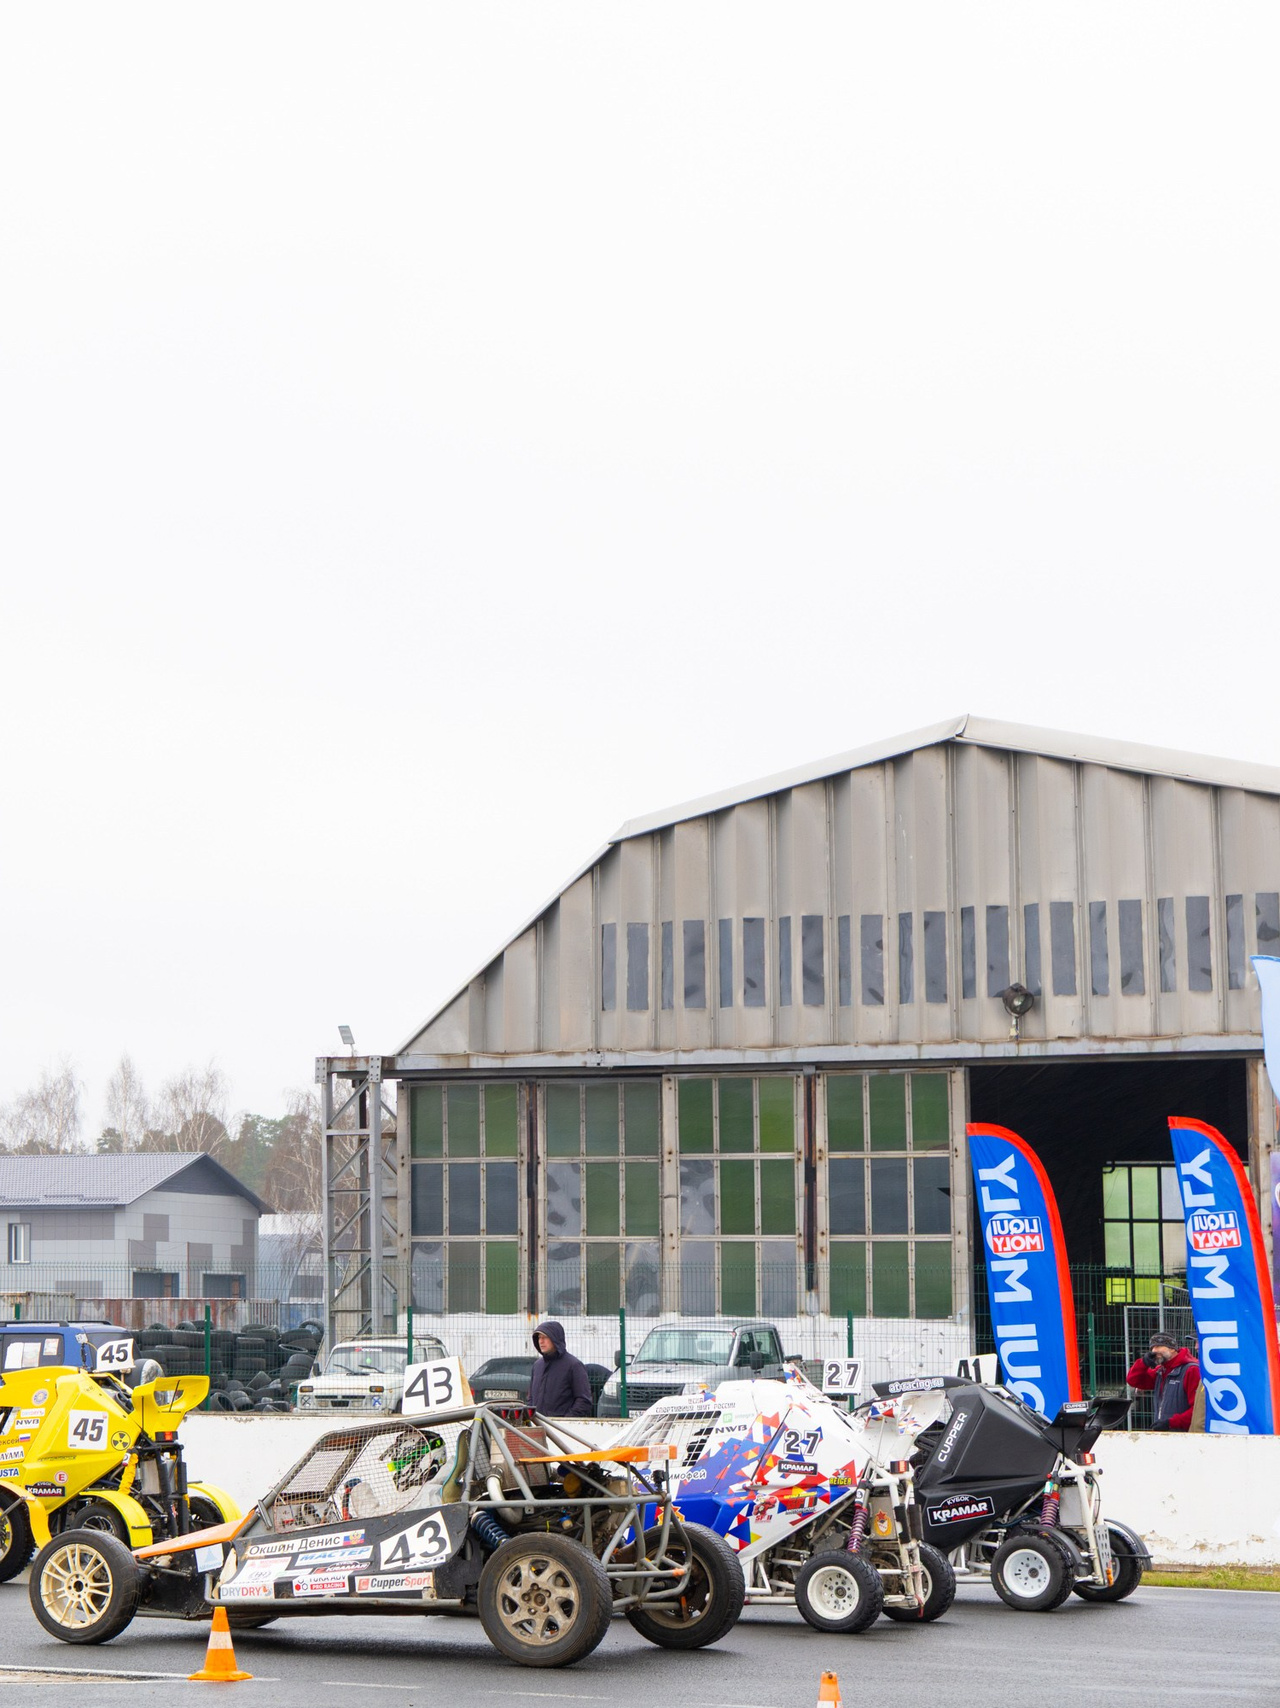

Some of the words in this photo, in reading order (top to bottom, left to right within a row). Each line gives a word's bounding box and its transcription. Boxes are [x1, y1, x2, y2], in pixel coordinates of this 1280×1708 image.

[100, 1343, 129, 1364] 45
[825, 1360, 861, 1388] 27
[405, 1366, 453, 1407] 43
[889, 1378, 944, 1393] at-racing.ru
[73, 1418, 104, 1442] 45
[715, 1424, 748, 1434] NWB
[938, 1412, 968, 1463] CUPPER
[784, 1429, 821, 1456] 27
[668, 1470, 706, 1481] имофей
[781, 1463, 815, 1472] КРАМАР
[933, 1502, 988, 1520] KRAMAR
[249, 1543, 295, 1556] Окшин
[298, 1536, 341, 1551] Денис
[384, 1520, 448, 1565] 43
[300, 1548, 370, 1562] МАСТЕР
[221, 1586, 262, 1597] DRYDRY
[370, 1575, 431, 1590] CupperSport
